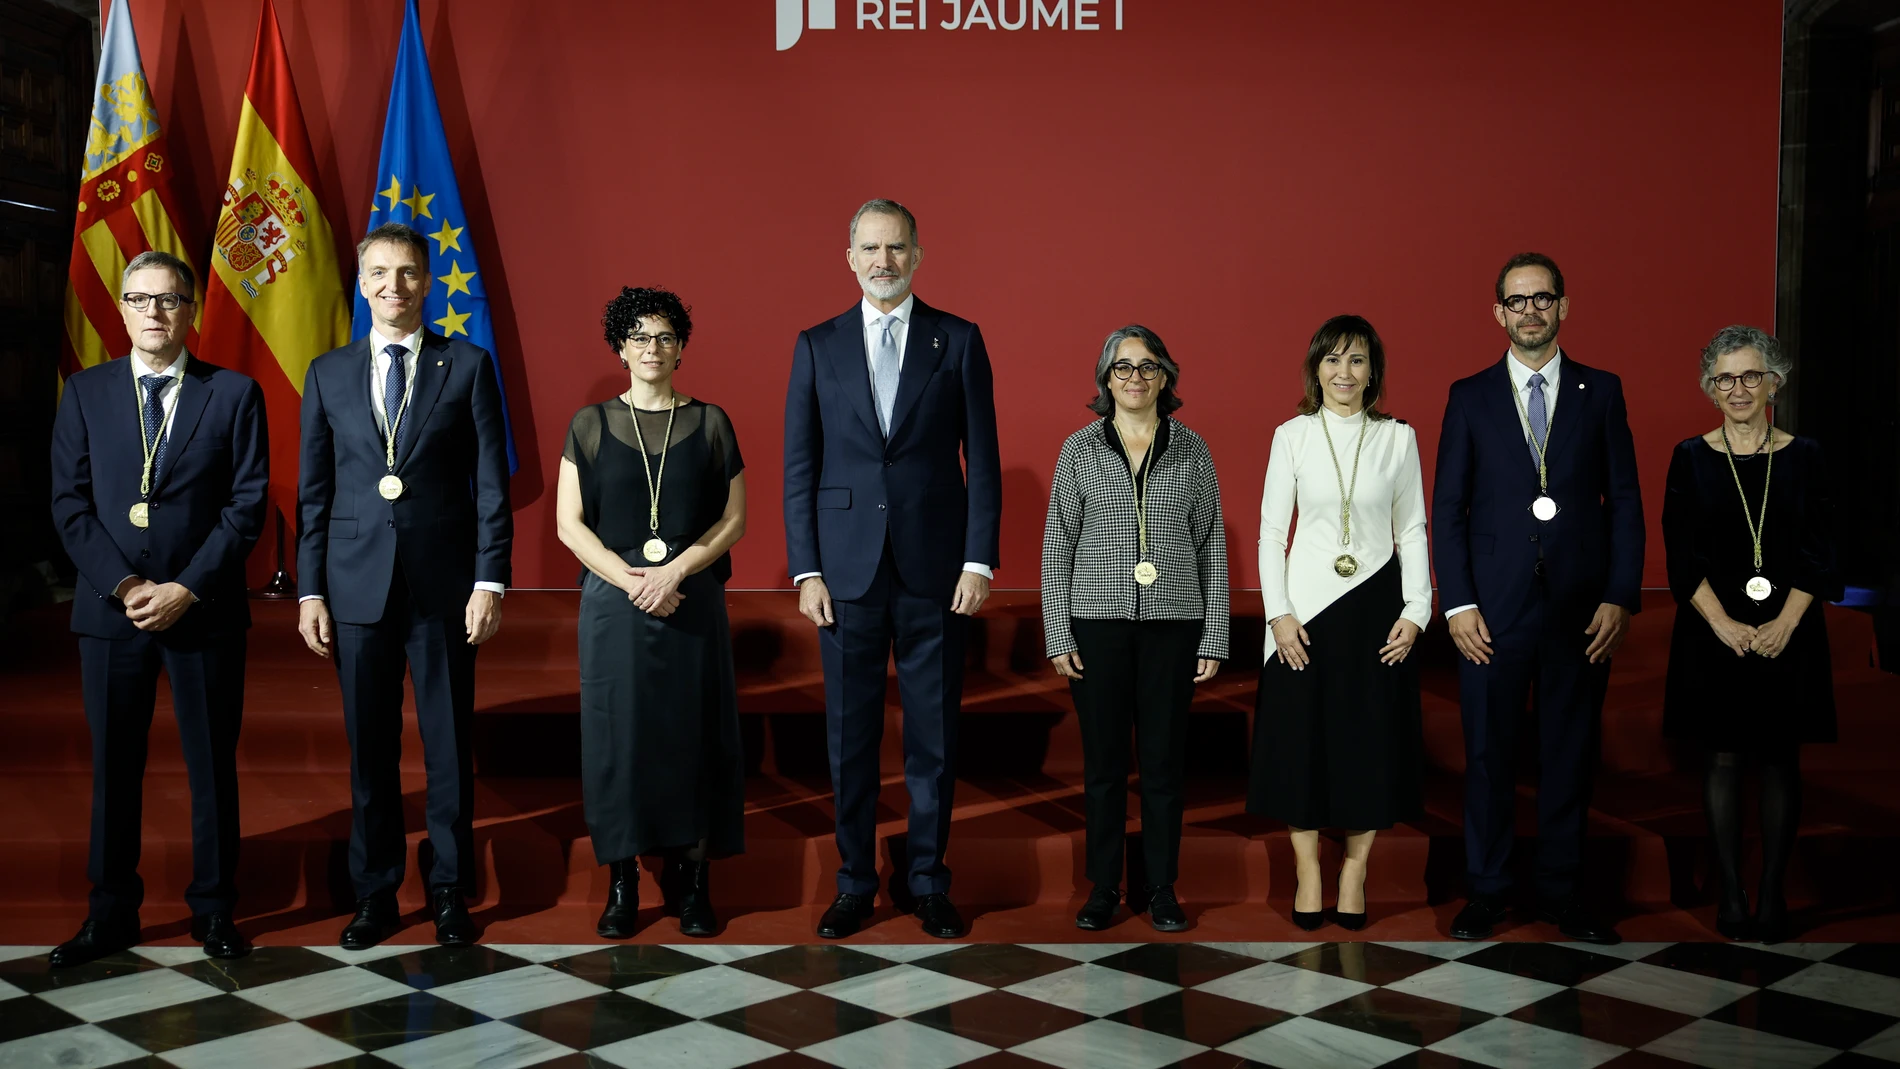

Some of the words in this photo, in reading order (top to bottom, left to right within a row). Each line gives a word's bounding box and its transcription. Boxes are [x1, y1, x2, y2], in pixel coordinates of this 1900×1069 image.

[856, 0, 927, 30] REI
[939, 0, 1100, 31] JAUME
[1115, 0, 1123, 31] I
